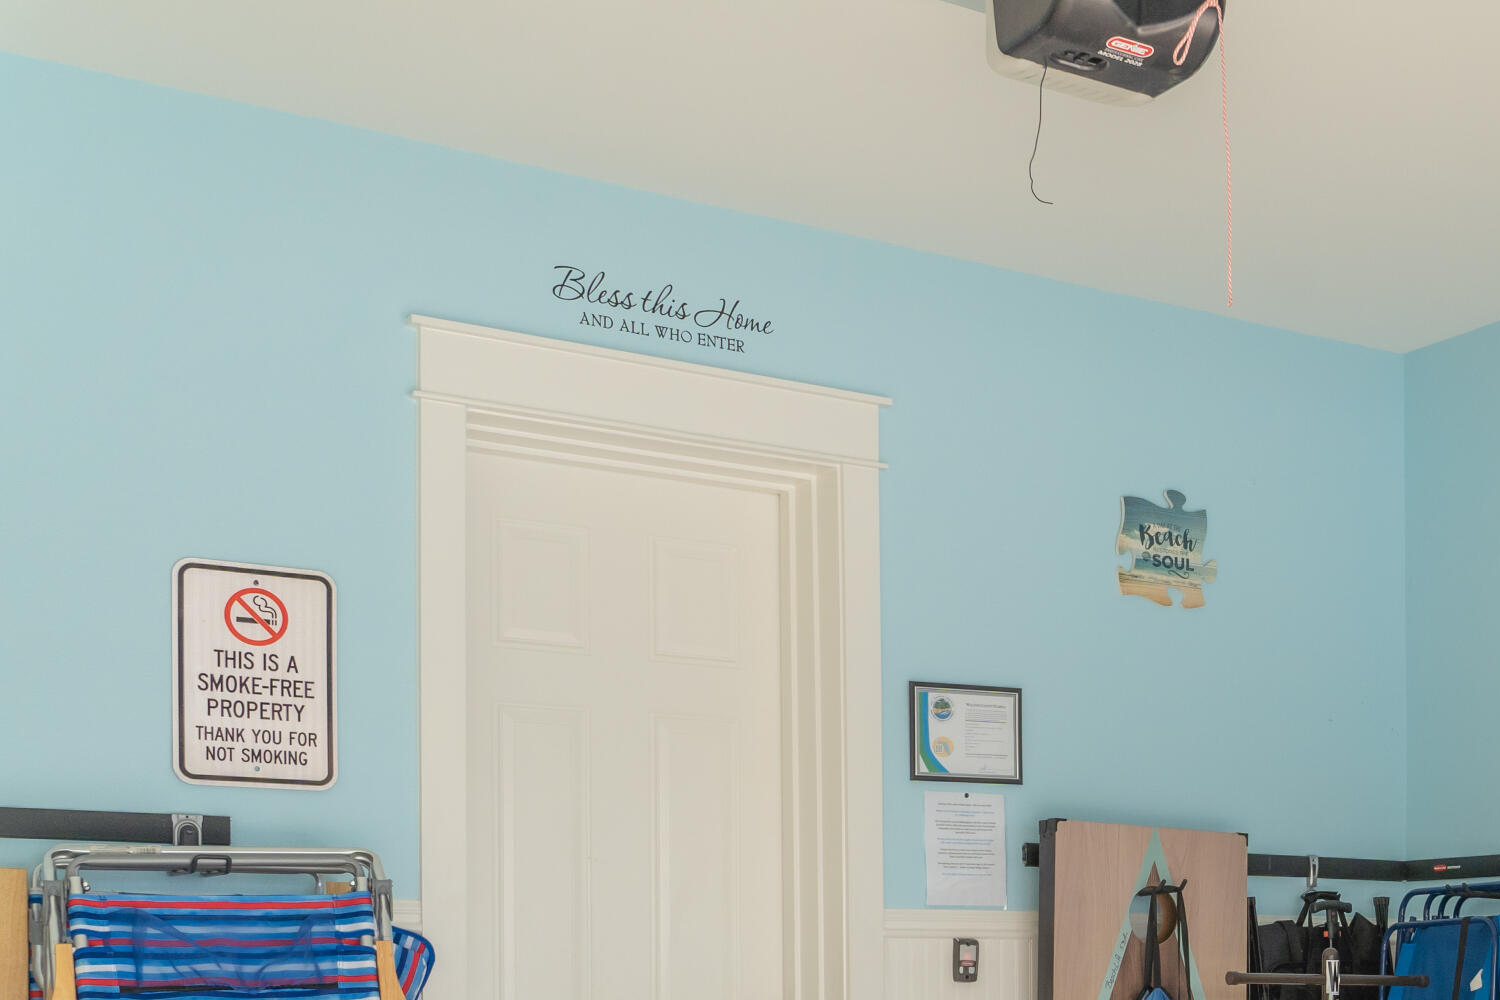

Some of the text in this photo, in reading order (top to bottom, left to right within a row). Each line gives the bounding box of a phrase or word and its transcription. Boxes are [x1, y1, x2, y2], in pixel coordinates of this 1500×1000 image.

[552, 265, 775, 335] Bless this Home
[579, 311, 745, 353] AND ALL WHO ENTER
[1139, 523, 1197, 552] Beach
[1152, 553, 1194, 572] SOUL
[213, 649, 299, 673] THIS IS A
[197, 673, 315, 699] SMOKE-FREE
[207, 699, 305, 722] PROPERTY
[195, 725, 318, 747] THANK YOU FOR
[205, 746, 308, 766] NOT SMOKING
